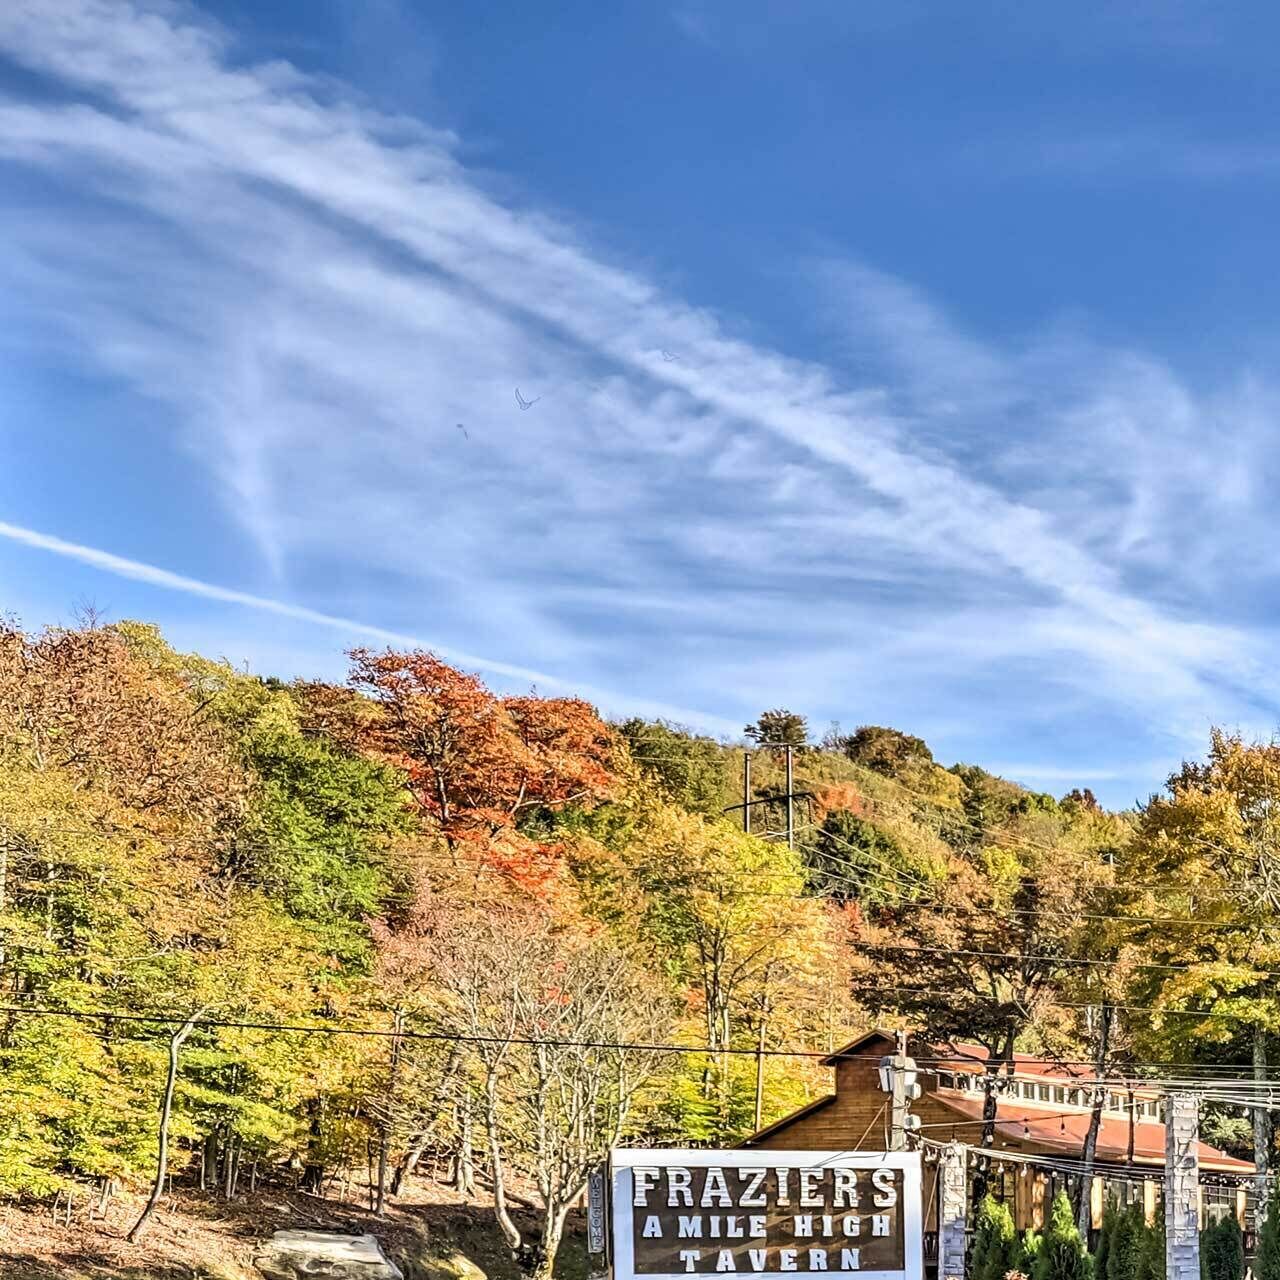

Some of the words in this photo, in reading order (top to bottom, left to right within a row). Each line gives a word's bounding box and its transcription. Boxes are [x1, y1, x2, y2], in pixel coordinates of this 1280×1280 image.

[632, 1167, 897, 1207] FRAZIERS
[643, 1215, 663, 1237] A
[678, 1215, 767, 1237] MILE
[793, 1215, 890, 1237] HIGH
[680, 1248, 860, 1272] TAVERN
